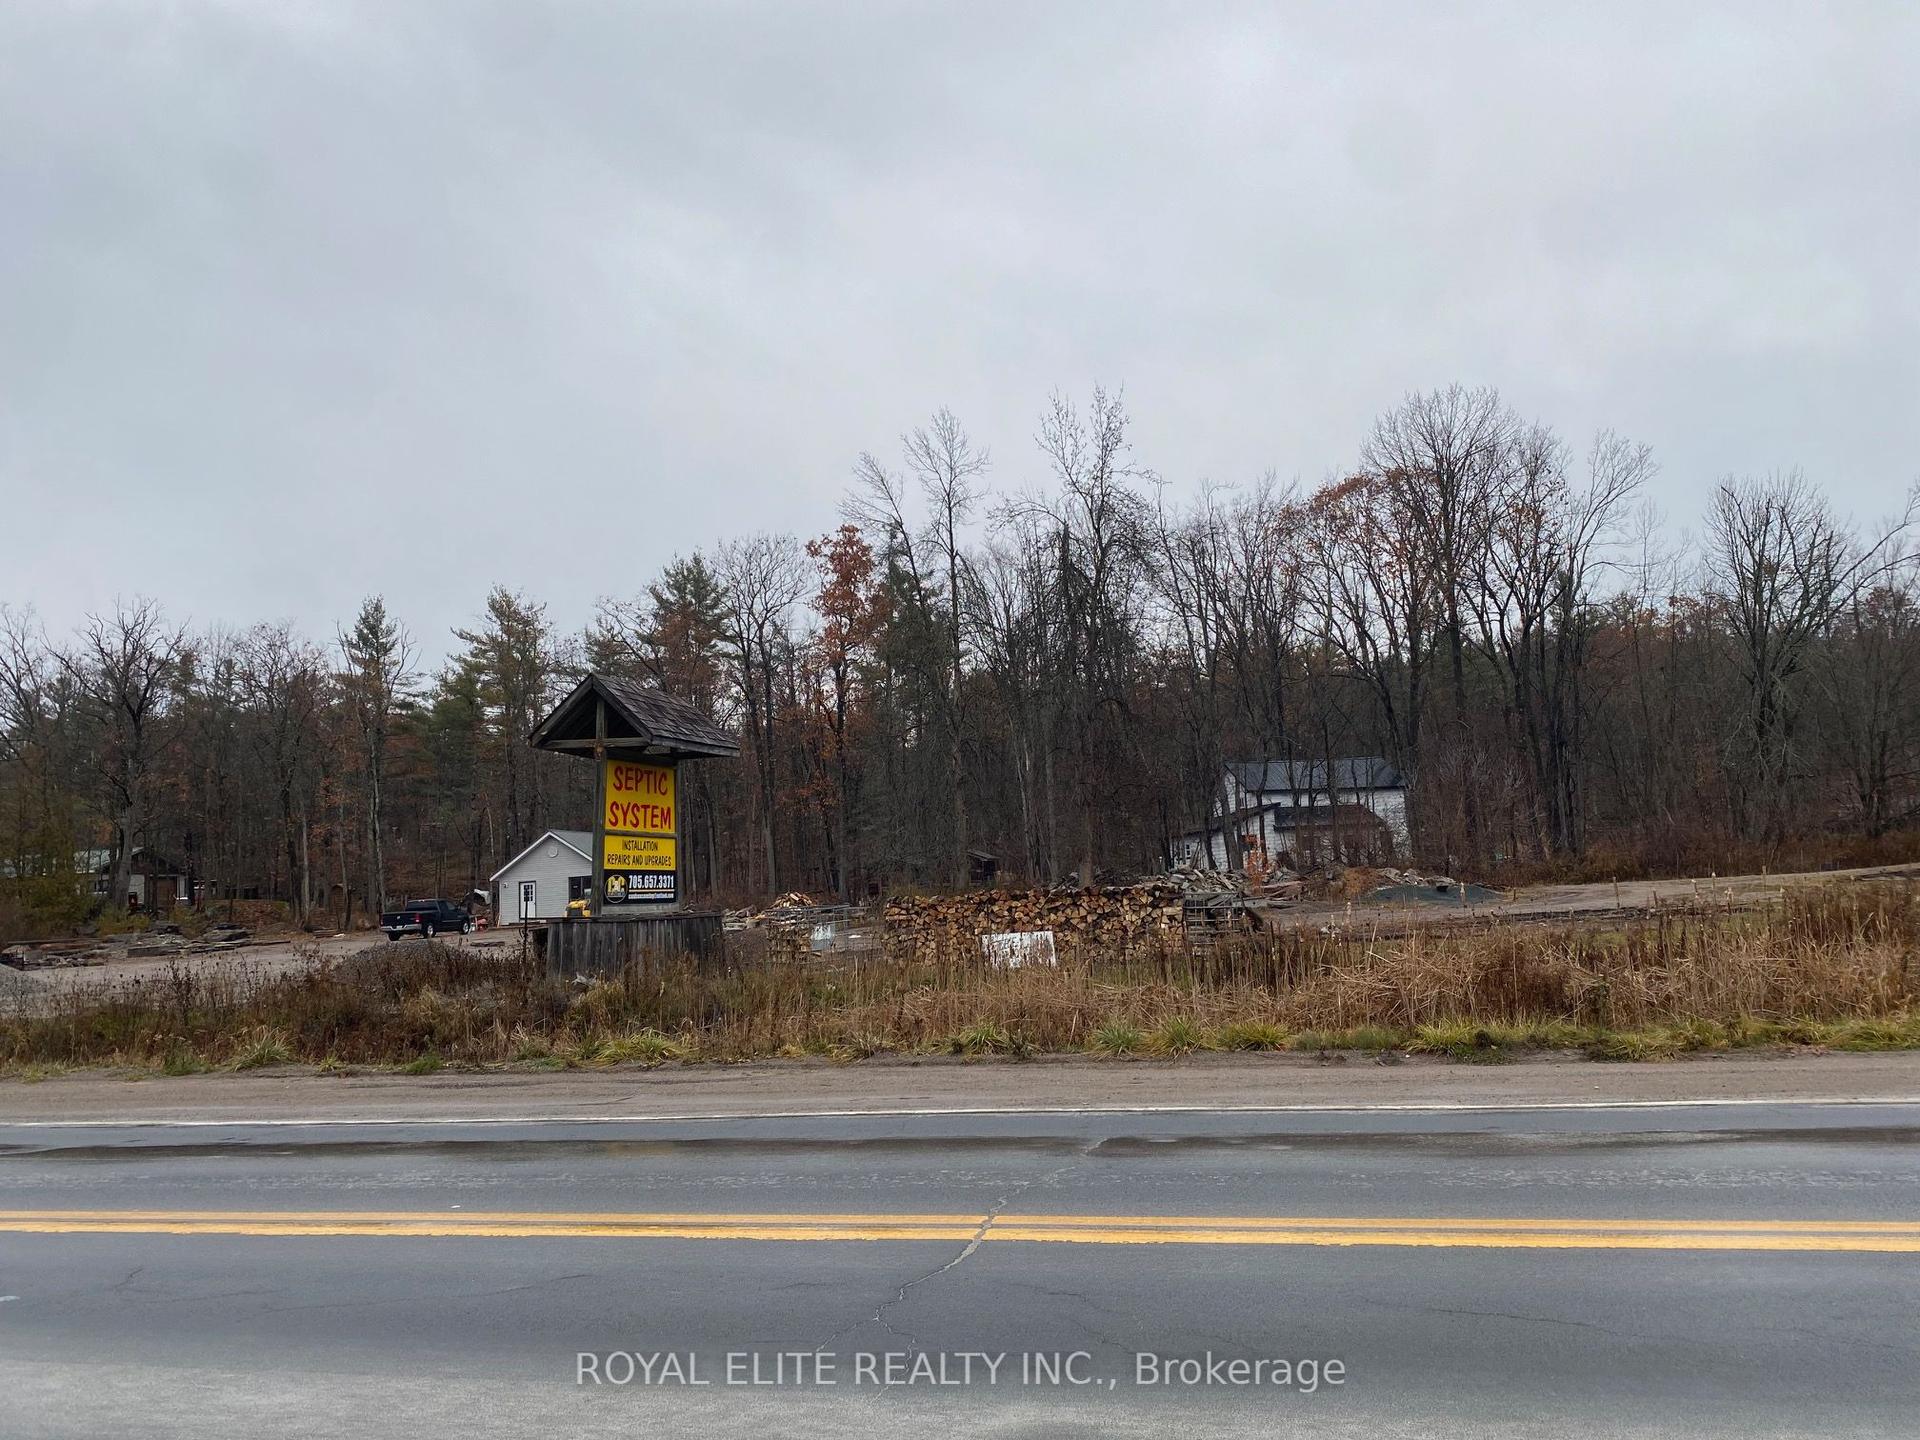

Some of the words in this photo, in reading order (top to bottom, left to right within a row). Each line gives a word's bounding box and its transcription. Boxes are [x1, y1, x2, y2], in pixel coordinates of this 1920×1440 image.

[613, 766, 668, 796] SEPTIC
[609, 801, 671, 829] SYSTEM
[622, 840, 658, 851] INSTALLATION
[607, 854, 630, 866] REPAIRS
[632, 855, 644, 866] AND
[645, 856, 672, 867] UPGRADES
[629, 875, 674, 888] 705.657.3371
